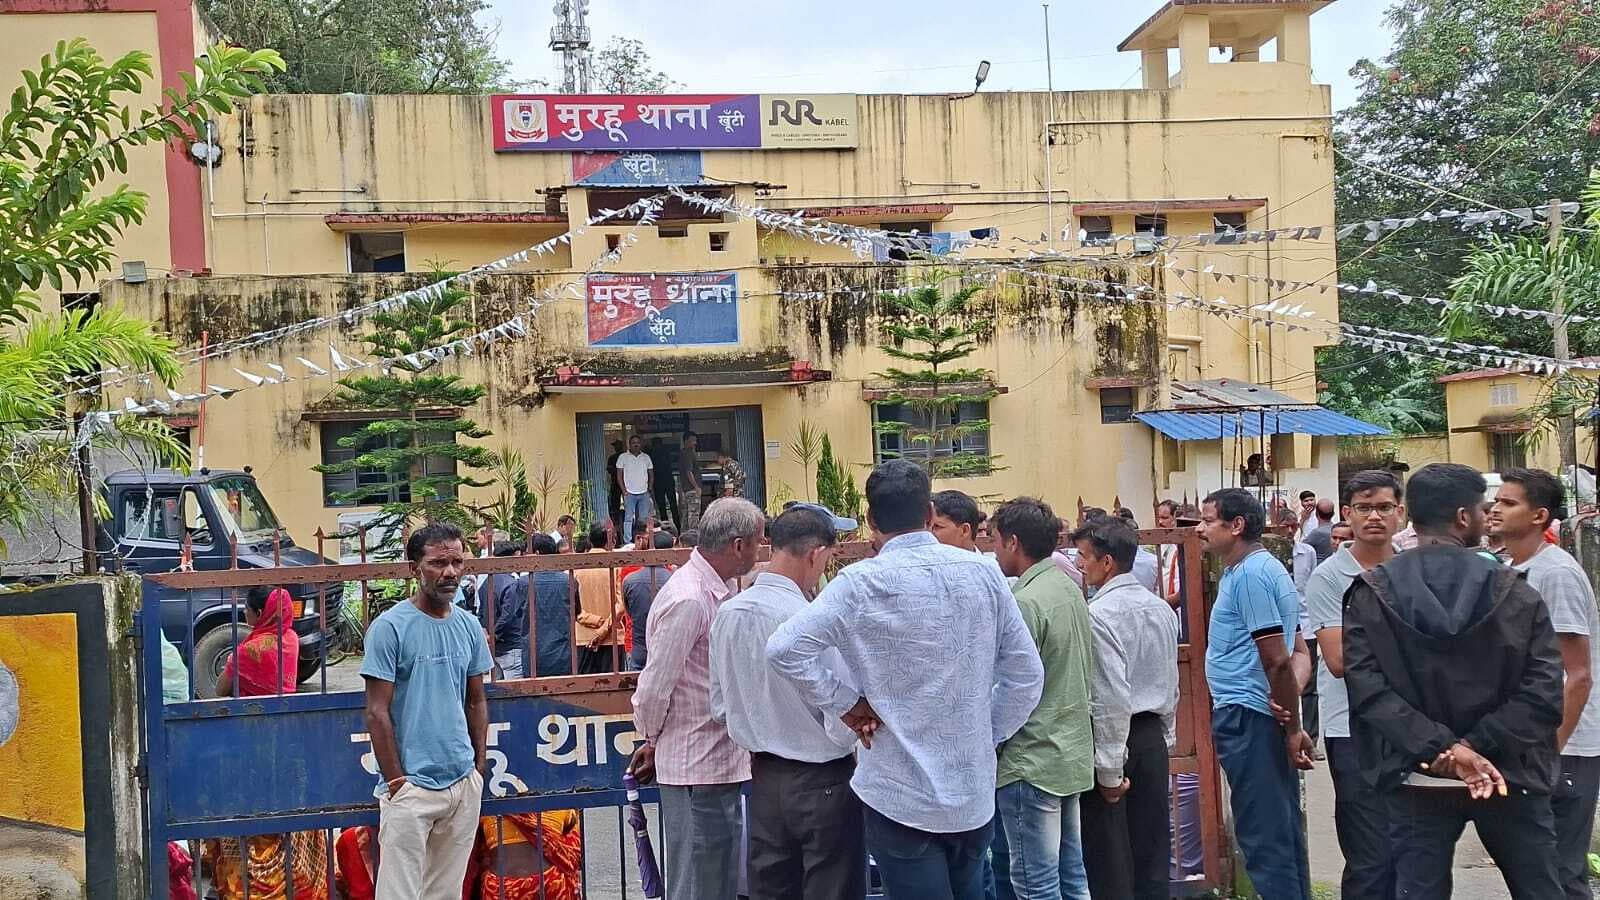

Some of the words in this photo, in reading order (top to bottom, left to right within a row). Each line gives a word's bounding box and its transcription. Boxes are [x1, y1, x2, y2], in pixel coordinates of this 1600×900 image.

[555, 103, 628, 142] मुरहू
[637, 103, 710, 131] थाना
[769, 99, 822, 126] RR
[825, 118, 849, 126] KABEL
[591, 284, 661, 322] मुरहू
[665, 284, 733, 304] थाना
